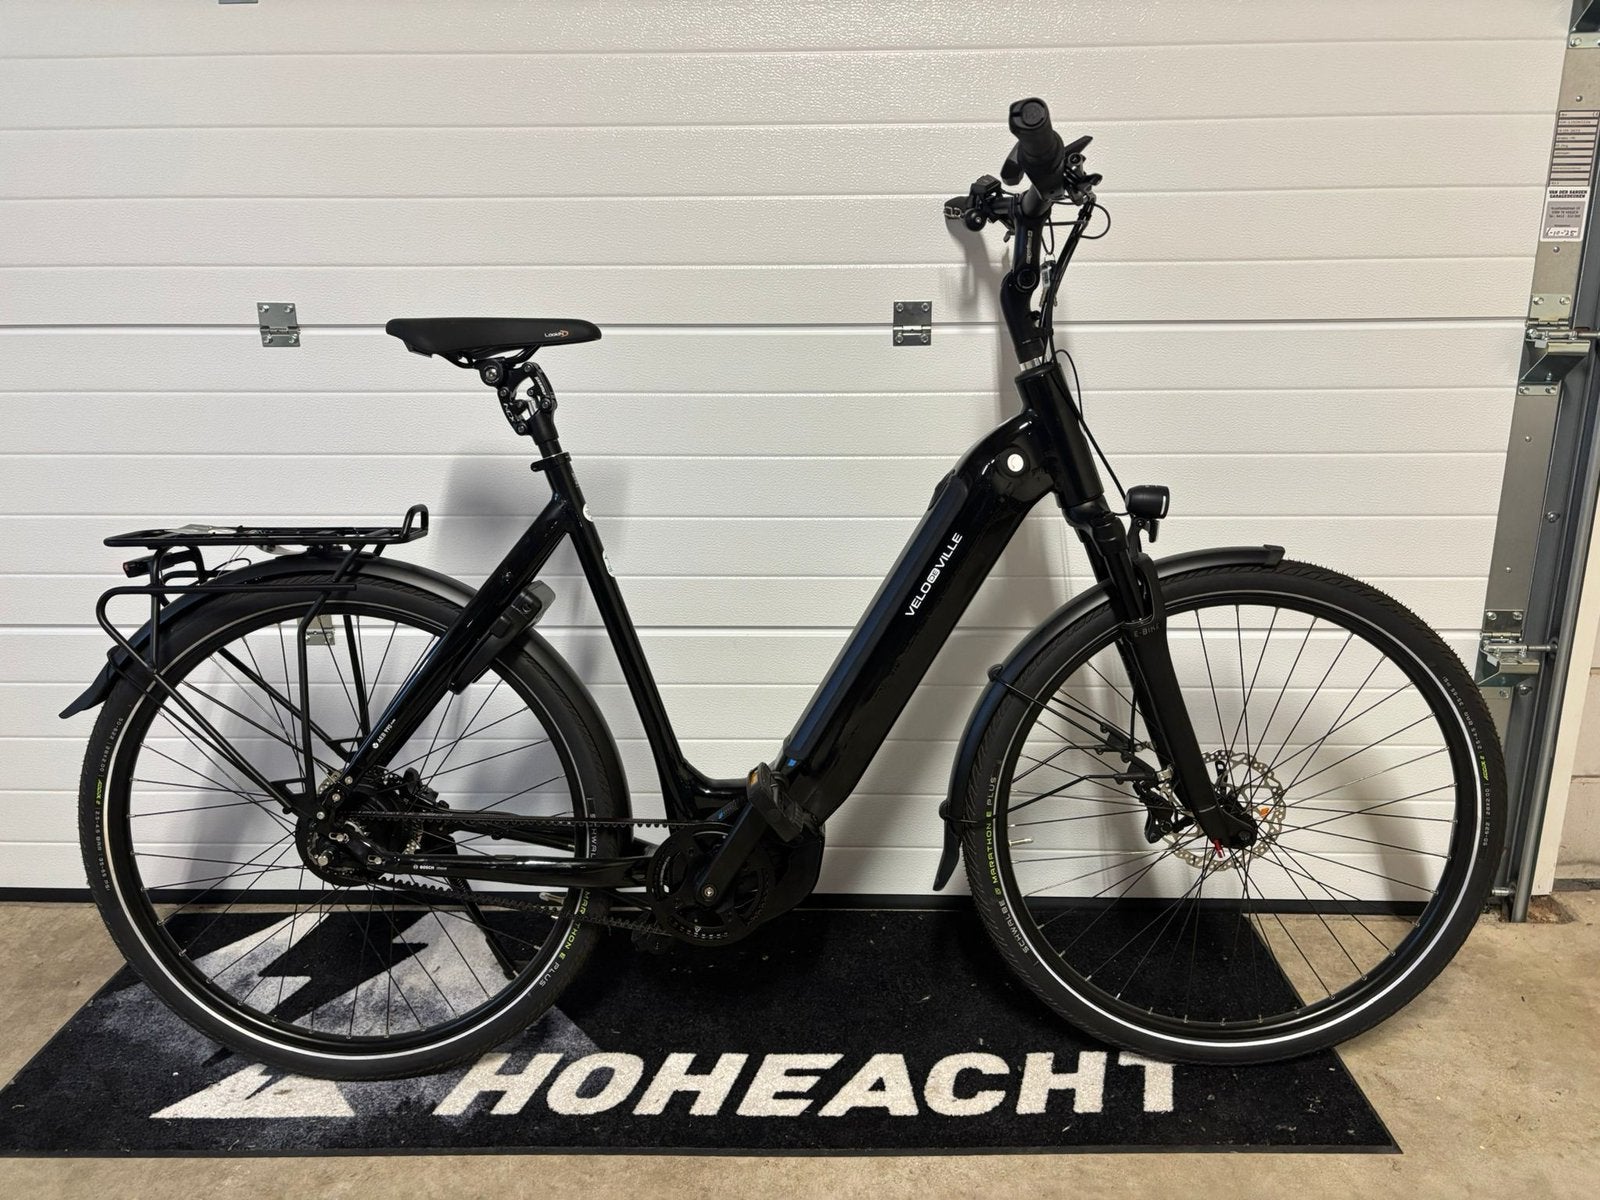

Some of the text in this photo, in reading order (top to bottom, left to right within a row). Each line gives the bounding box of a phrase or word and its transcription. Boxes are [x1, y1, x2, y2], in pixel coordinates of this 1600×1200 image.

[905, 581, 931, 616] VELO
[934, 532, 963, 568] VILLE
[986, 776, 997, 806] PLUS
[985, 823, 999, 884] MARATHON
[565, 890, 590, 950] MARTHON
[998, 899, 1030, 954] SCHWALBE
[539, 961, 560, 987] PLUS
[431, 1051, 1175, 1117] HOHEACHT
